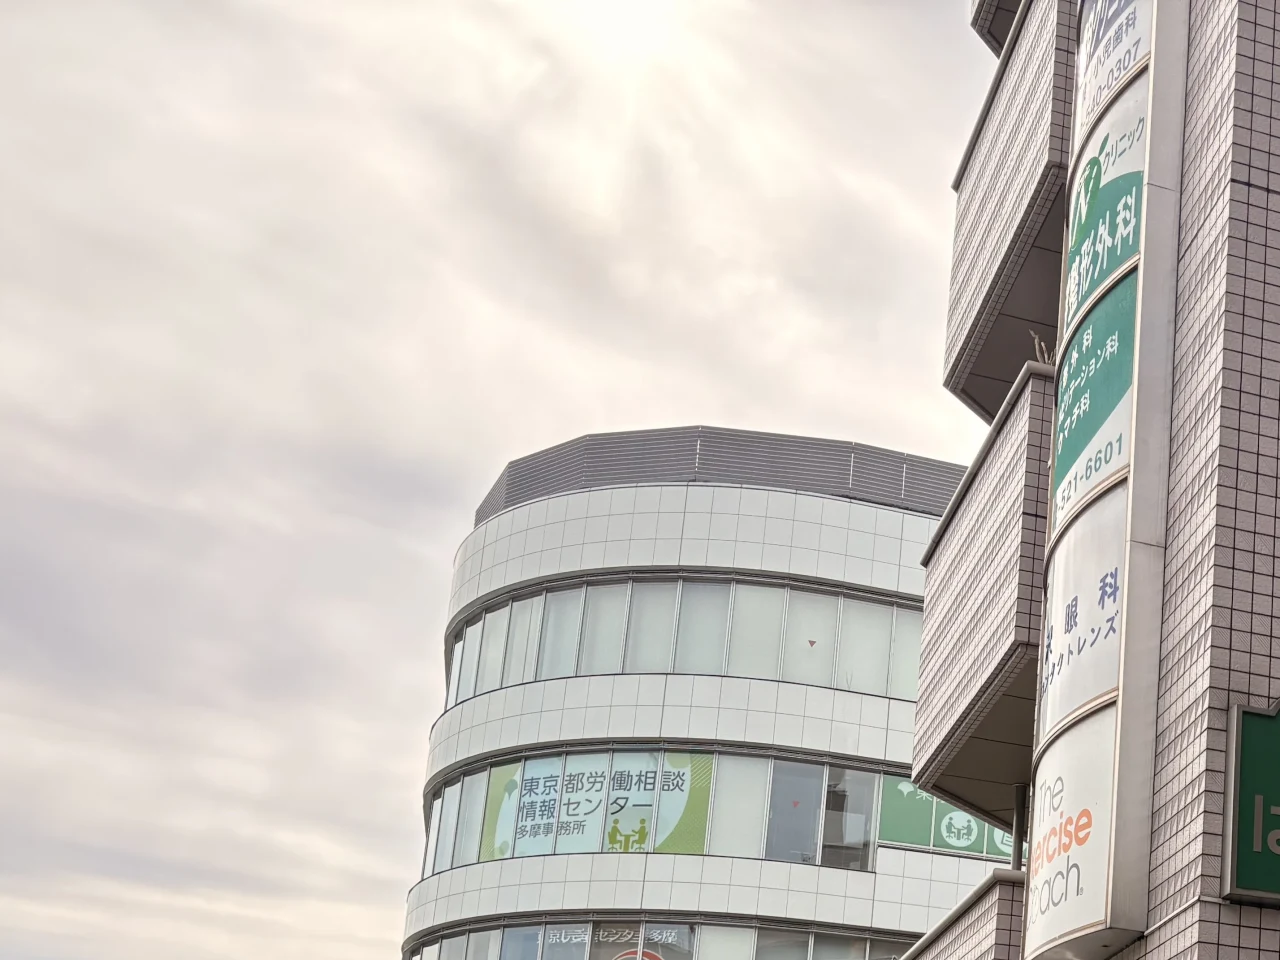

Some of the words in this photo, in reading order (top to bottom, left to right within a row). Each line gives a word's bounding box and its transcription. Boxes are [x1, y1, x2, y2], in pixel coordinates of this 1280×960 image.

[1103, 116, 1145, 176] クリニック
[521, 769, 686, 798] 東京都労働相談
[518, 797, 653, 822] 情報センター
[1038, 775, 1064, 828] The
[516, 819, 587, 839] 多摩事務所
